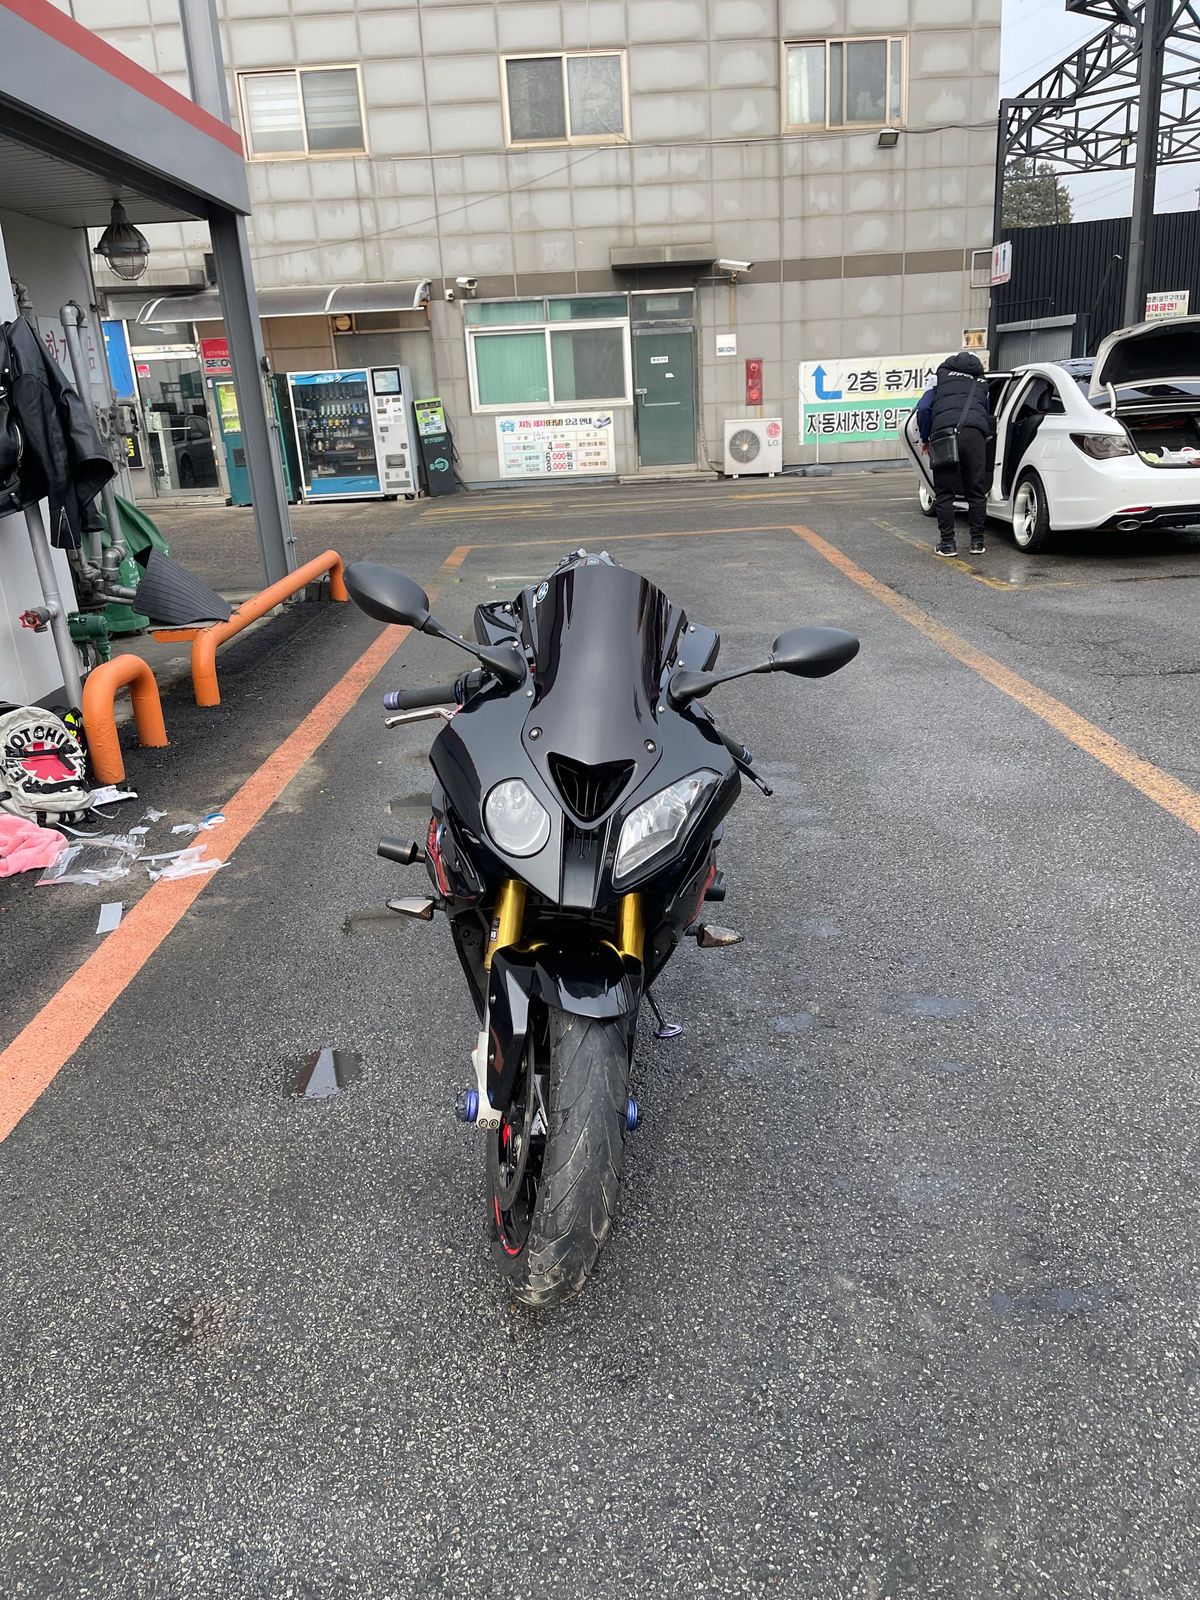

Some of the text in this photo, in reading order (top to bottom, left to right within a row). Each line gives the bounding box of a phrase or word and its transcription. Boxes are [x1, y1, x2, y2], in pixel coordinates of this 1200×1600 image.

[847, 371, 878, 392] 2층
[565, 418, 578, 426] 요금
[580, 417, 592, 425] 안내
[807, 410, 880, 435] 자동세차장
[768, 439, 779, 447] LG
